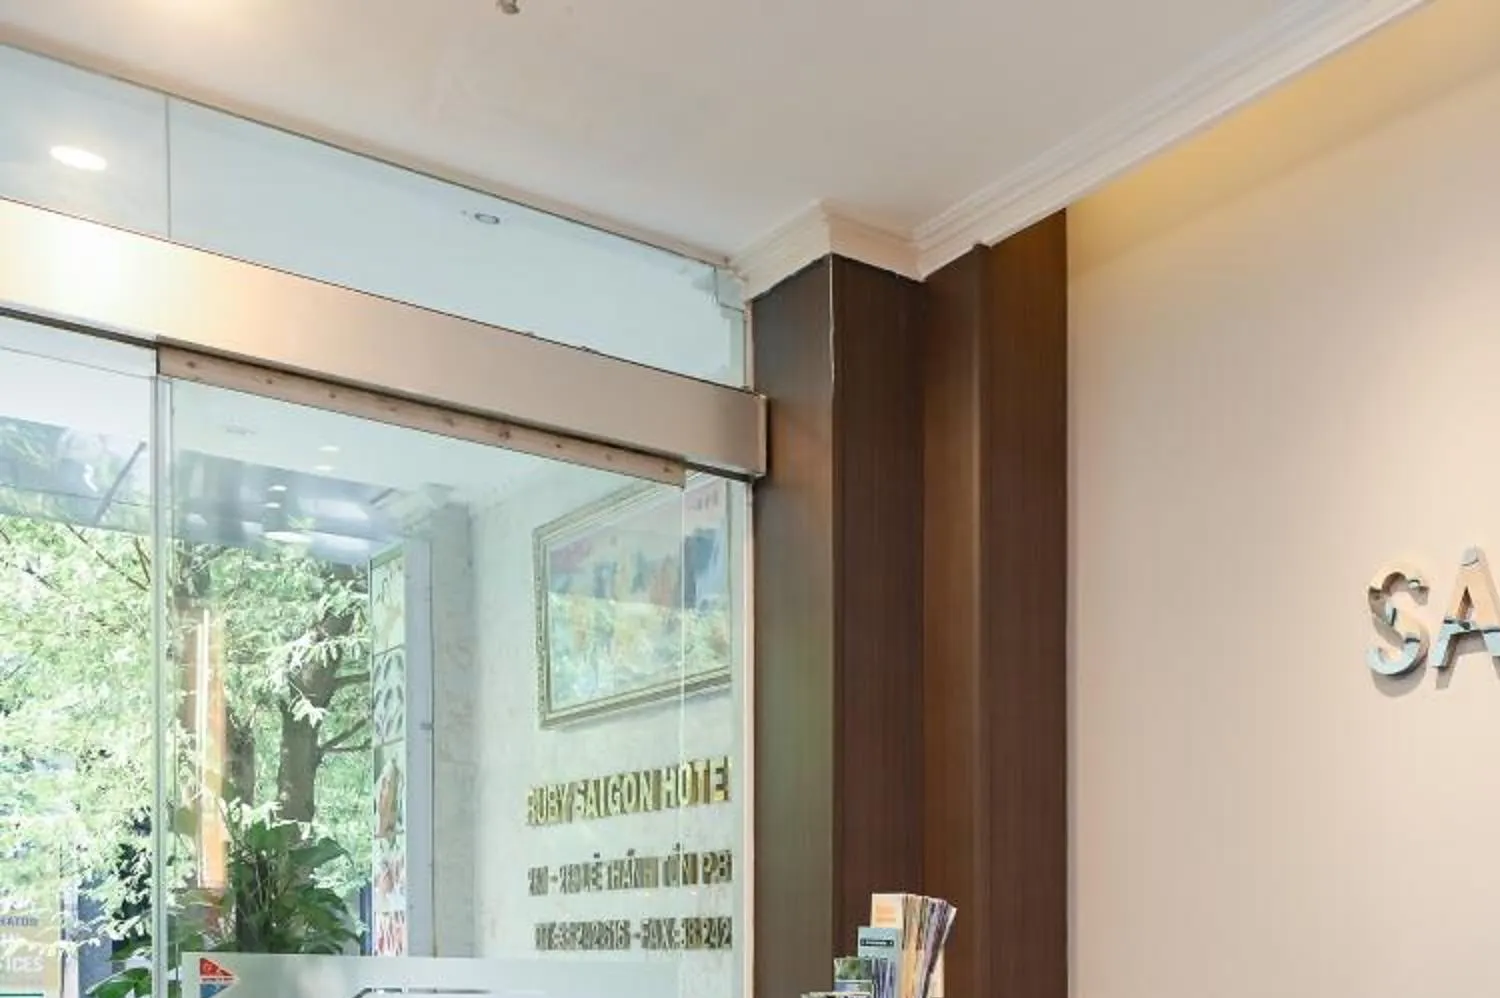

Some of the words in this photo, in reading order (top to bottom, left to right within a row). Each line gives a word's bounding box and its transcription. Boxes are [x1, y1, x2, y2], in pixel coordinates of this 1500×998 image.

[527, 782, 573, 827] RUBY
[575, 769, 661, 820] SAIGON
[661, 756, 732, 811] HOTE
